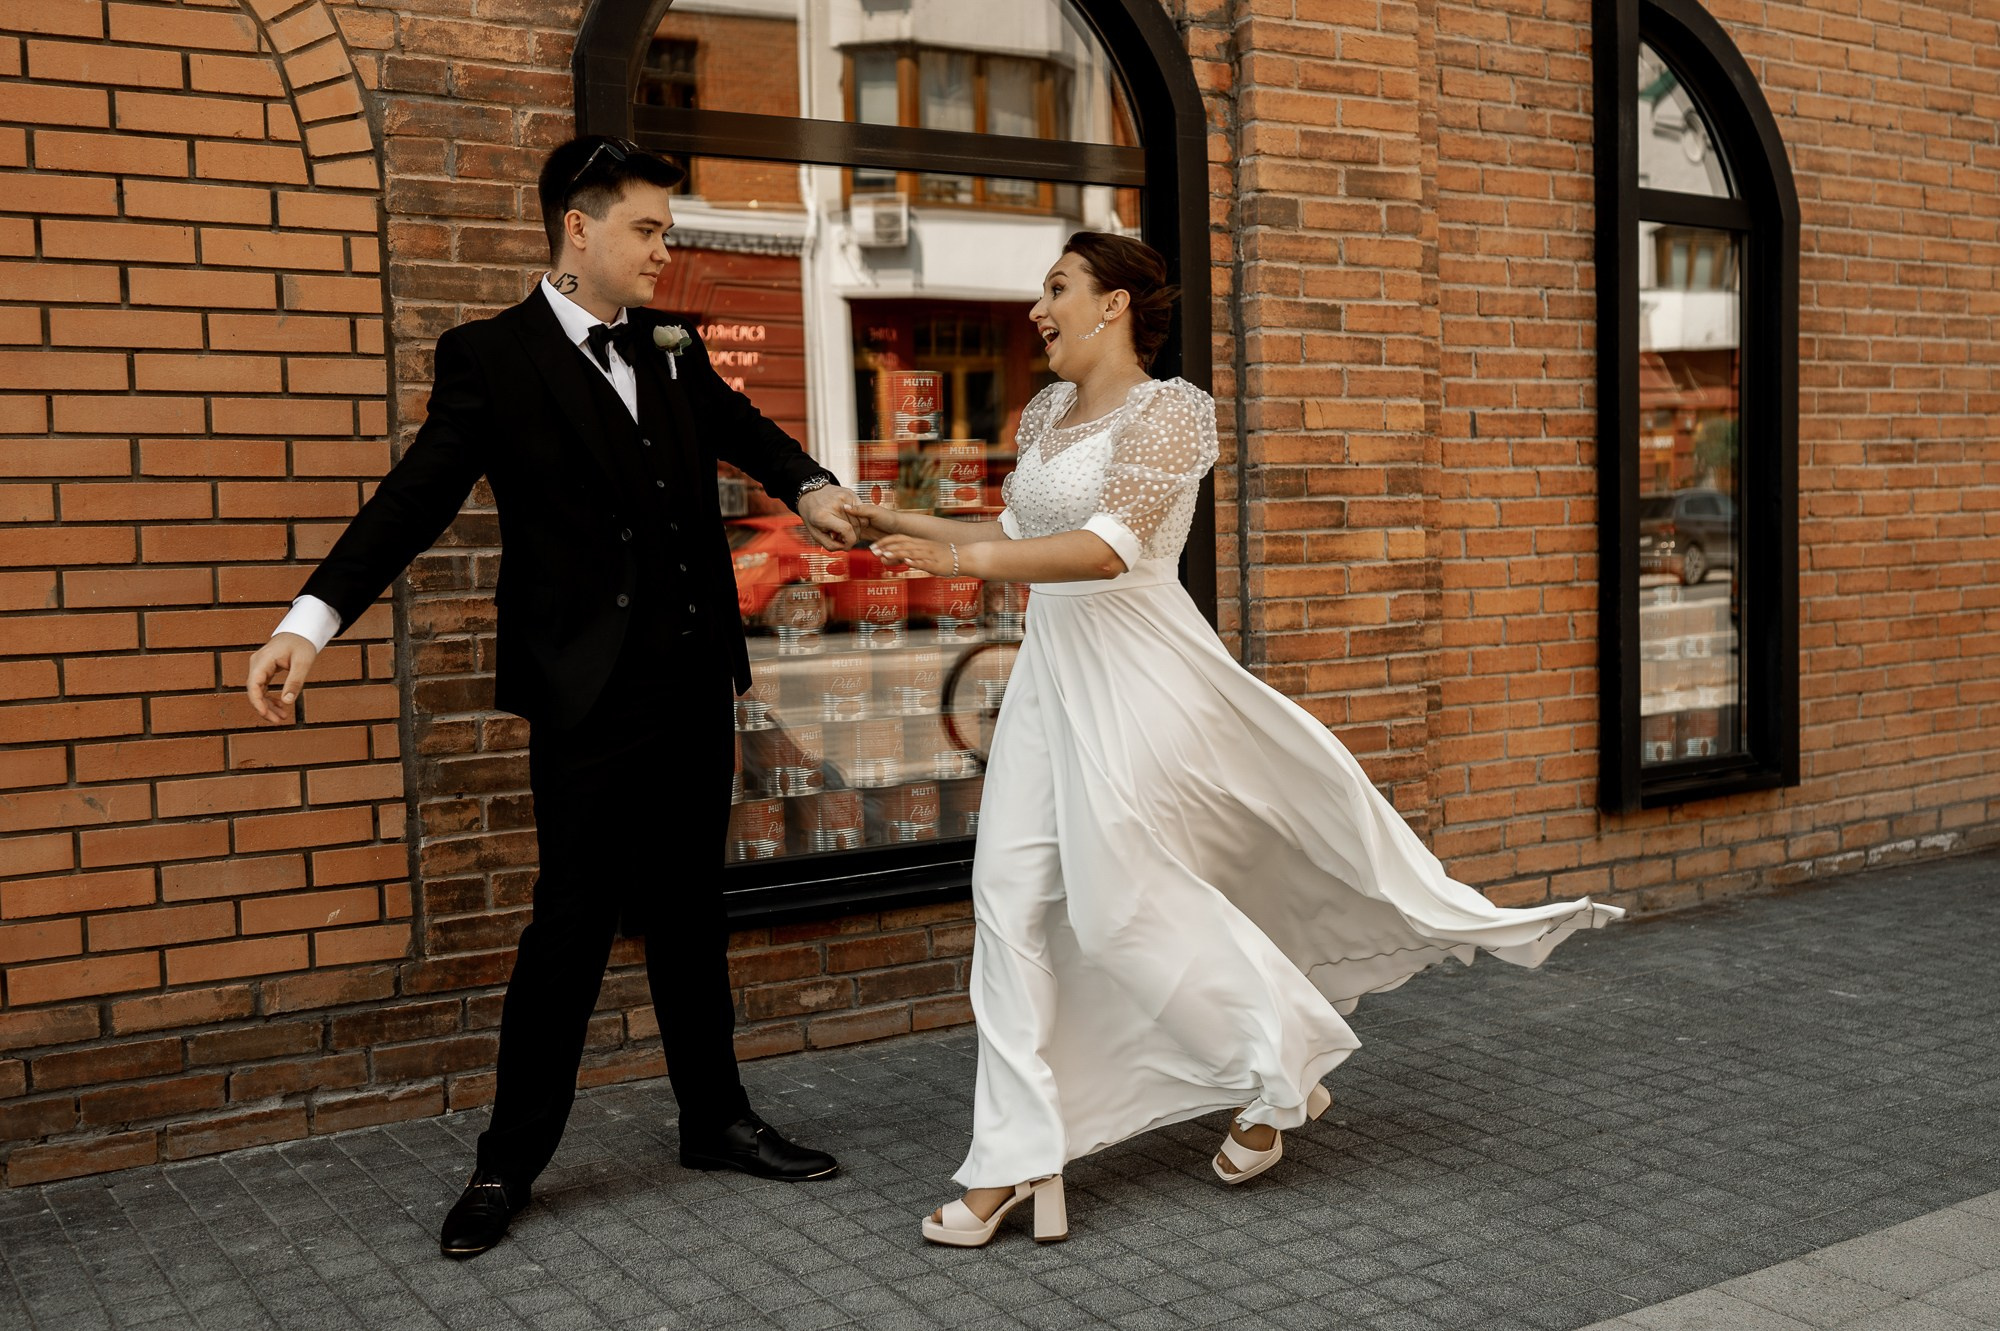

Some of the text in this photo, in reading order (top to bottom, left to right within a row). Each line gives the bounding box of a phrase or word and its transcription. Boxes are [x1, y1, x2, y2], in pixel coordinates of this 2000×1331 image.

[903, 378, 933, 387] MUTTI
[901, 394, 934, 411] Pelati
[949, 446, 979, 455] MUTTI
[948, 462, 979, 479] Pelati
[867, 586, 898, 596] MUTTI
[950, 582, 979, 592] MUTTI
[792, 590, 821, 600] MUTTI
[865, 603, 899, 620] Pelati
[949, 599, 979, 615] Pelati
[832, 658, 863, 668] MUTTI
